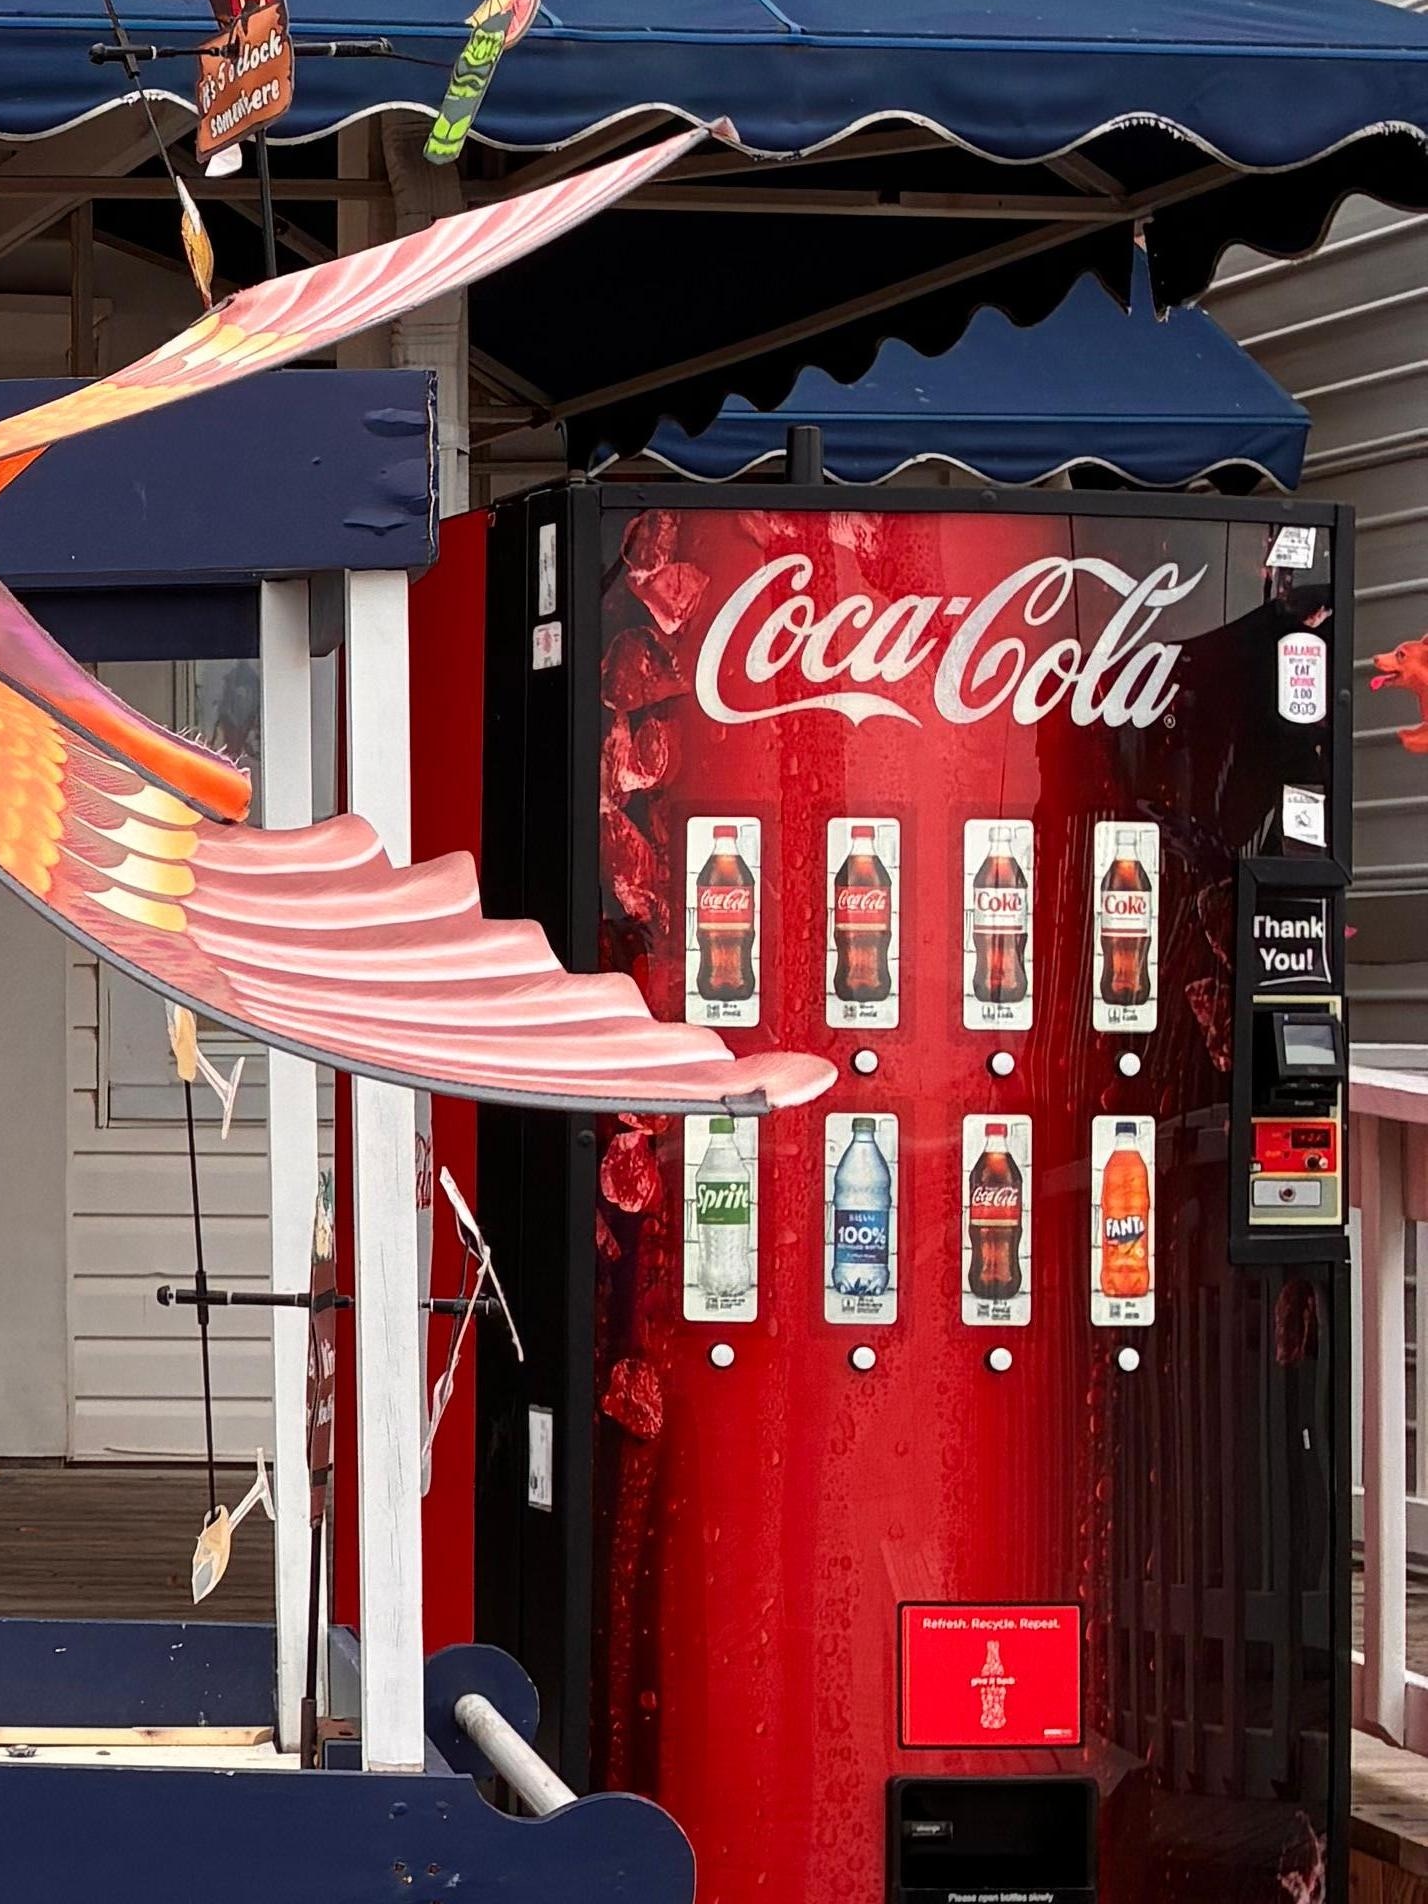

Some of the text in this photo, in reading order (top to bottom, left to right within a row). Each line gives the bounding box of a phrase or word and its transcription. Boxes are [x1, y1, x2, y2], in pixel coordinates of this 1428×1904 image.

[218, 62, 226, 92] 5
[210, 78, 280, 139] somewhere
[695, 553, 1208, 729] Coca-Cola
[977, 892, 1022, 912] Coke
[1104, 895, 1147, 915] Coke
[1253, 915, 1323, 938] Thank
[1259, 948, 1313, 971] You!
[838, 1226, 886, 1244] 100%
[922, 1617, 1061, 1631] Refresh. Recycle. Repeat.
[948, 1892, 976, 1903] Please
